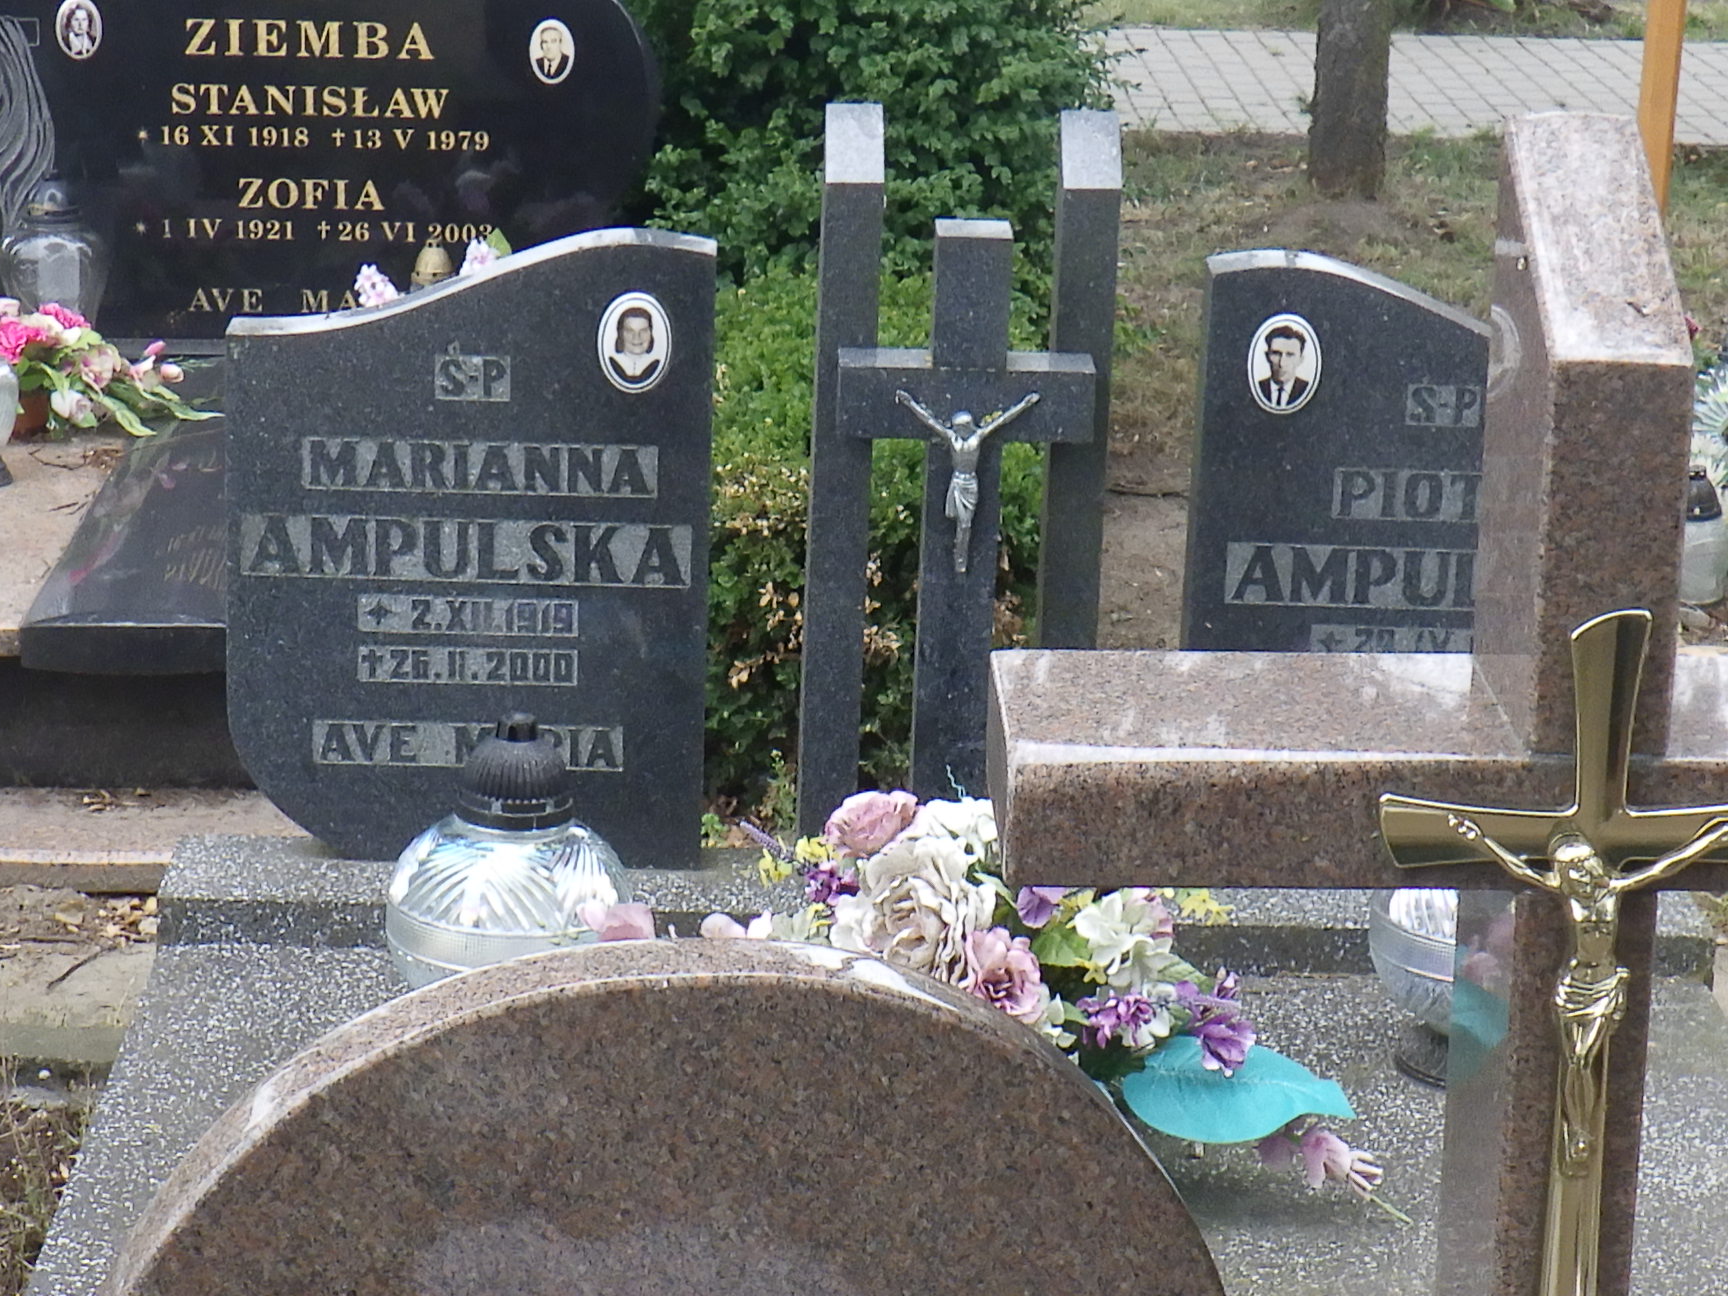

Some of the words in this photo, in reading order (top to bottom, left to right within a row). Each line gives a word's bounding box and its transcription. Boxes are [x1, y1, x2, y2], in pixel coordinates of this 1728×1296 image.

[183, 17, 436, 61] ZIEMBA
[170, 82, 450, 121] STANISŁAW
[161, 124, 190, 147] 16
[201, 124, 235, 148] XI
[248, 126, 311, 149] 1918
[394, 128, 416, 151] V
[427, 129, 491, 152] 1979
[237, 177, 386, 212] ZOFIA
[187, 218, 224, 240] IV
[236, 219, 295, 242] 1921
[382, 221, 418, 244] VI
[427, 222, 493, 245] 2003
[188, 287, 264, 314] AVE
[307, 437, 653, 496] MARIANNA
[1337, 469, 1484, 523] PIOT
[253, 515, 690, 588] AMPULSKA
[320, 721, 418, 766] AVE
